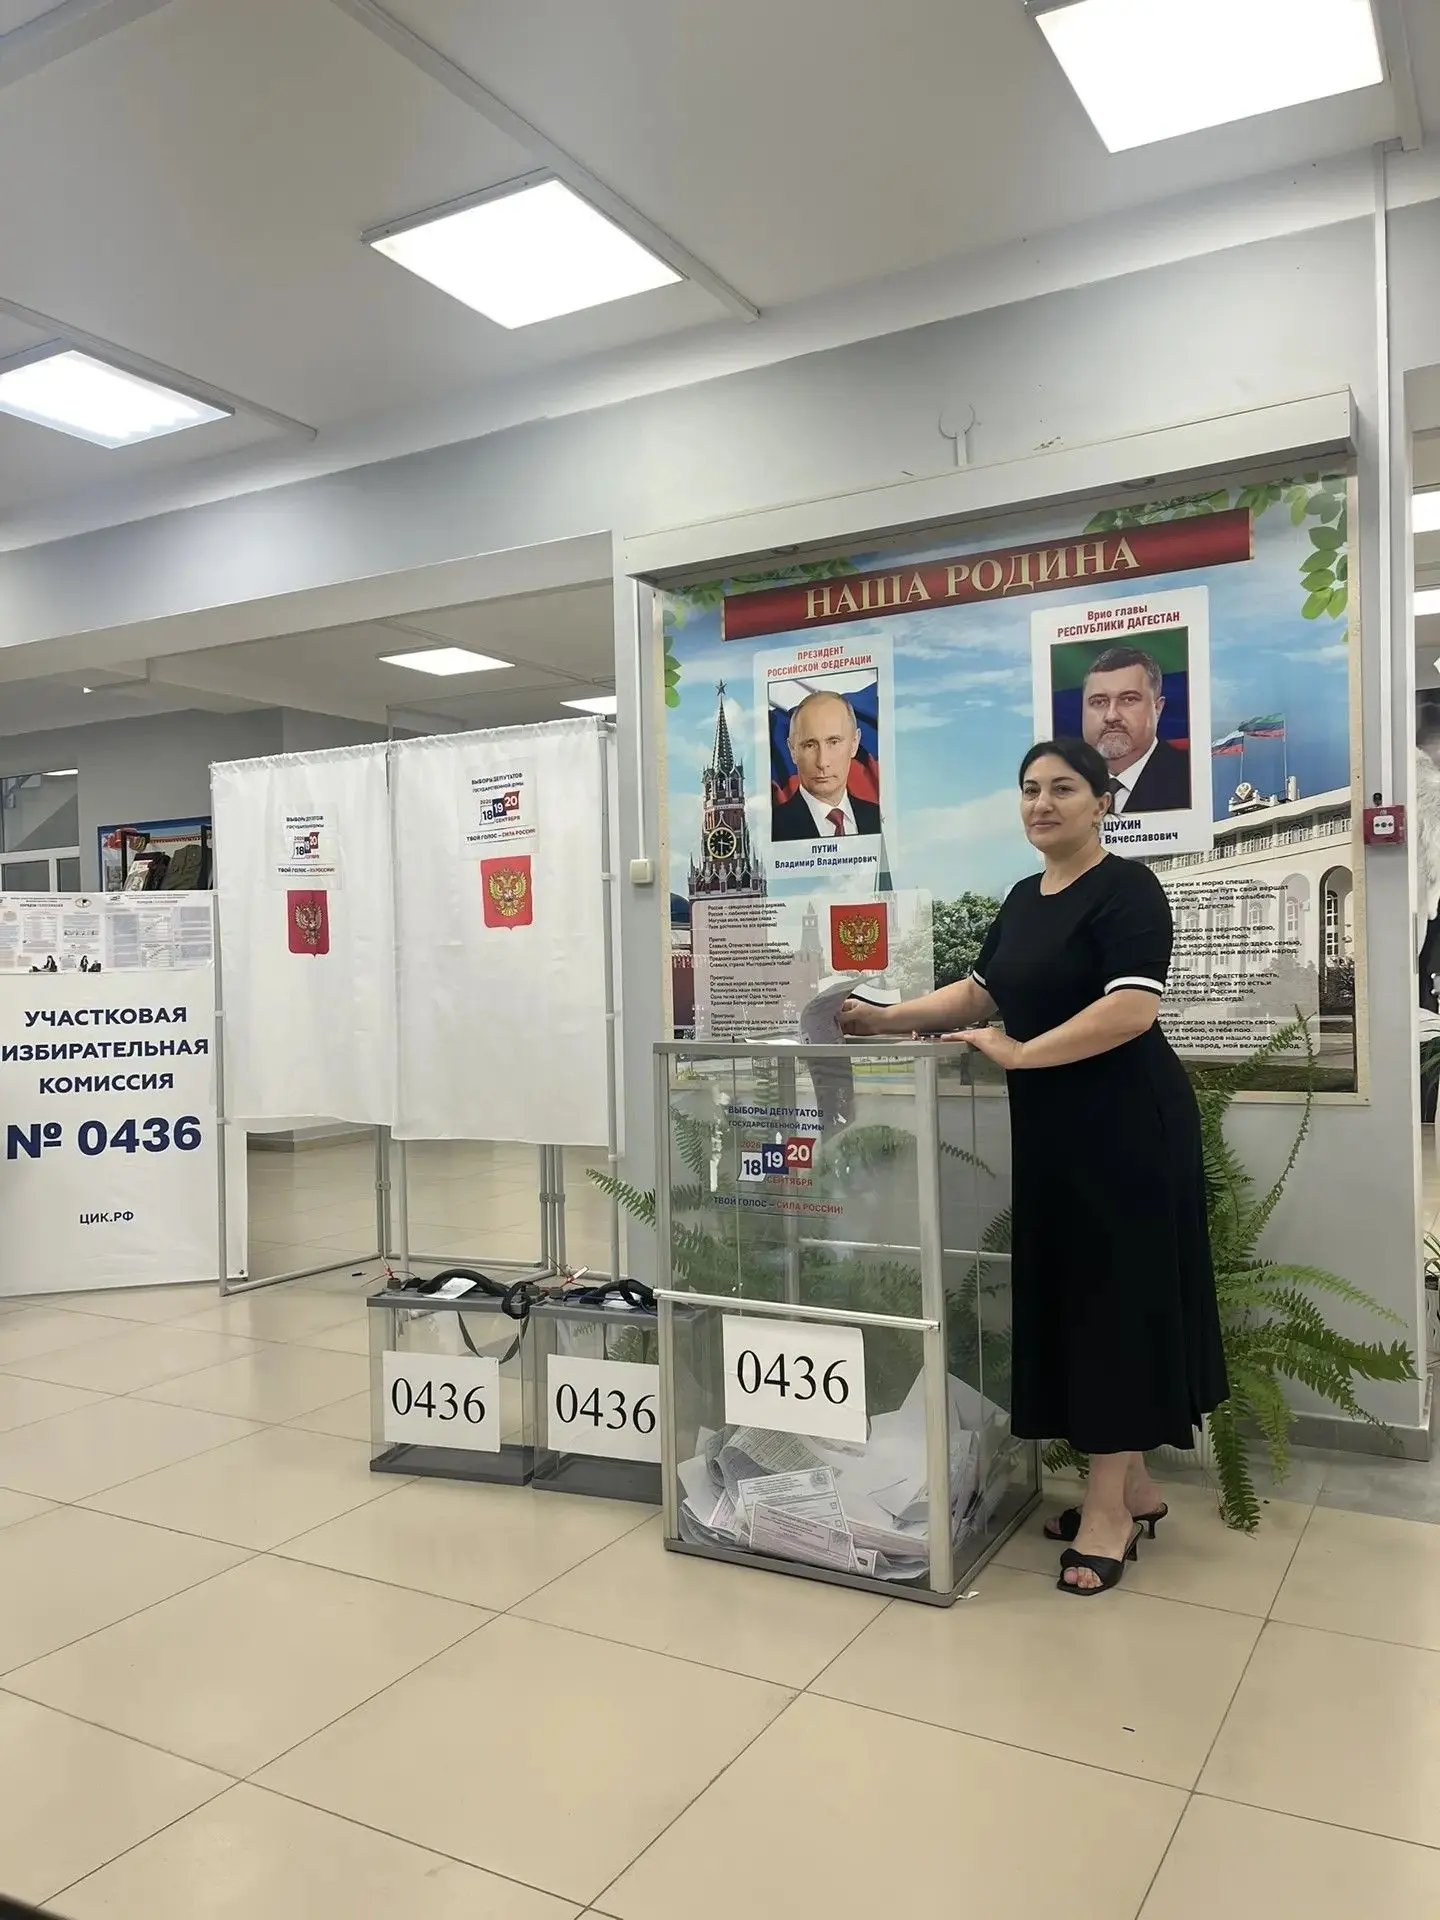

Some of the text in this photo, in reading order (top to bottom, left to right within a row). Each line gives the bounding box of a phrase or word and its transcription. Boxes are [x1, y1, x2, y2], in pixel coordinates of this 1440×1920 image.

[804, 537, 1140, 619] НАША РОДИНА
[1087, 605, 1148, 621] Врио главы
[1057, 611, 1180, 637] РЕСПУБЛИКИ ДАГЕСТАН
[797, 646, 844, 660] ПРЕЗИДЕНТ
[767, 655, 872, 677] РОССИЙСКОЙ ФЕДЕРАЦИИ
[482, 796, 518, 820] 18 19 20
[1103, 819, 1141, 832] ЩУКИН
[1105, 832, 1178, 844] Вячеславович
[295, 846, 305, 855] 18
[811, 844, 838, 854] ПУТИН
[775, 855, 877, 869] Владимир Владимирович
[1212, 972, 1249, 980] братство
[24, 1006, 187, 1028] УЧАСТКОВАЯ
[1, 1038, 209, 1062] ИЗБИРАТЕЛЬНАЯ
[39, 1073, 174, 1094] КОМИССИЯ
[728, 1105, 824, 1118] ВЫБОРЫ ДЕПУТАТОВ
[728, 1120, 825, 1132] ГОСУДАРСТВЕННОЙ ДУМЫ
[7, 1115, 201, 1160] № 0436
[743, 1144, 810, 1176] 18 19 20
[766, 1176, 813, 1187] СЕНТЯБРЯ
[738, 1198, 767, 1207] ГОЛОС
[776, 1200, 801, 1211] СИЛА
[802, 1202, 844, 1214] РОССИИ!
[79, 1210, 134, 1225] ЦИК.РФ
[736, 1349, 850, 1405] 0436
[391, 1377, 486, 1424] 0436
[555, 1383, 657, 1434] 0436
